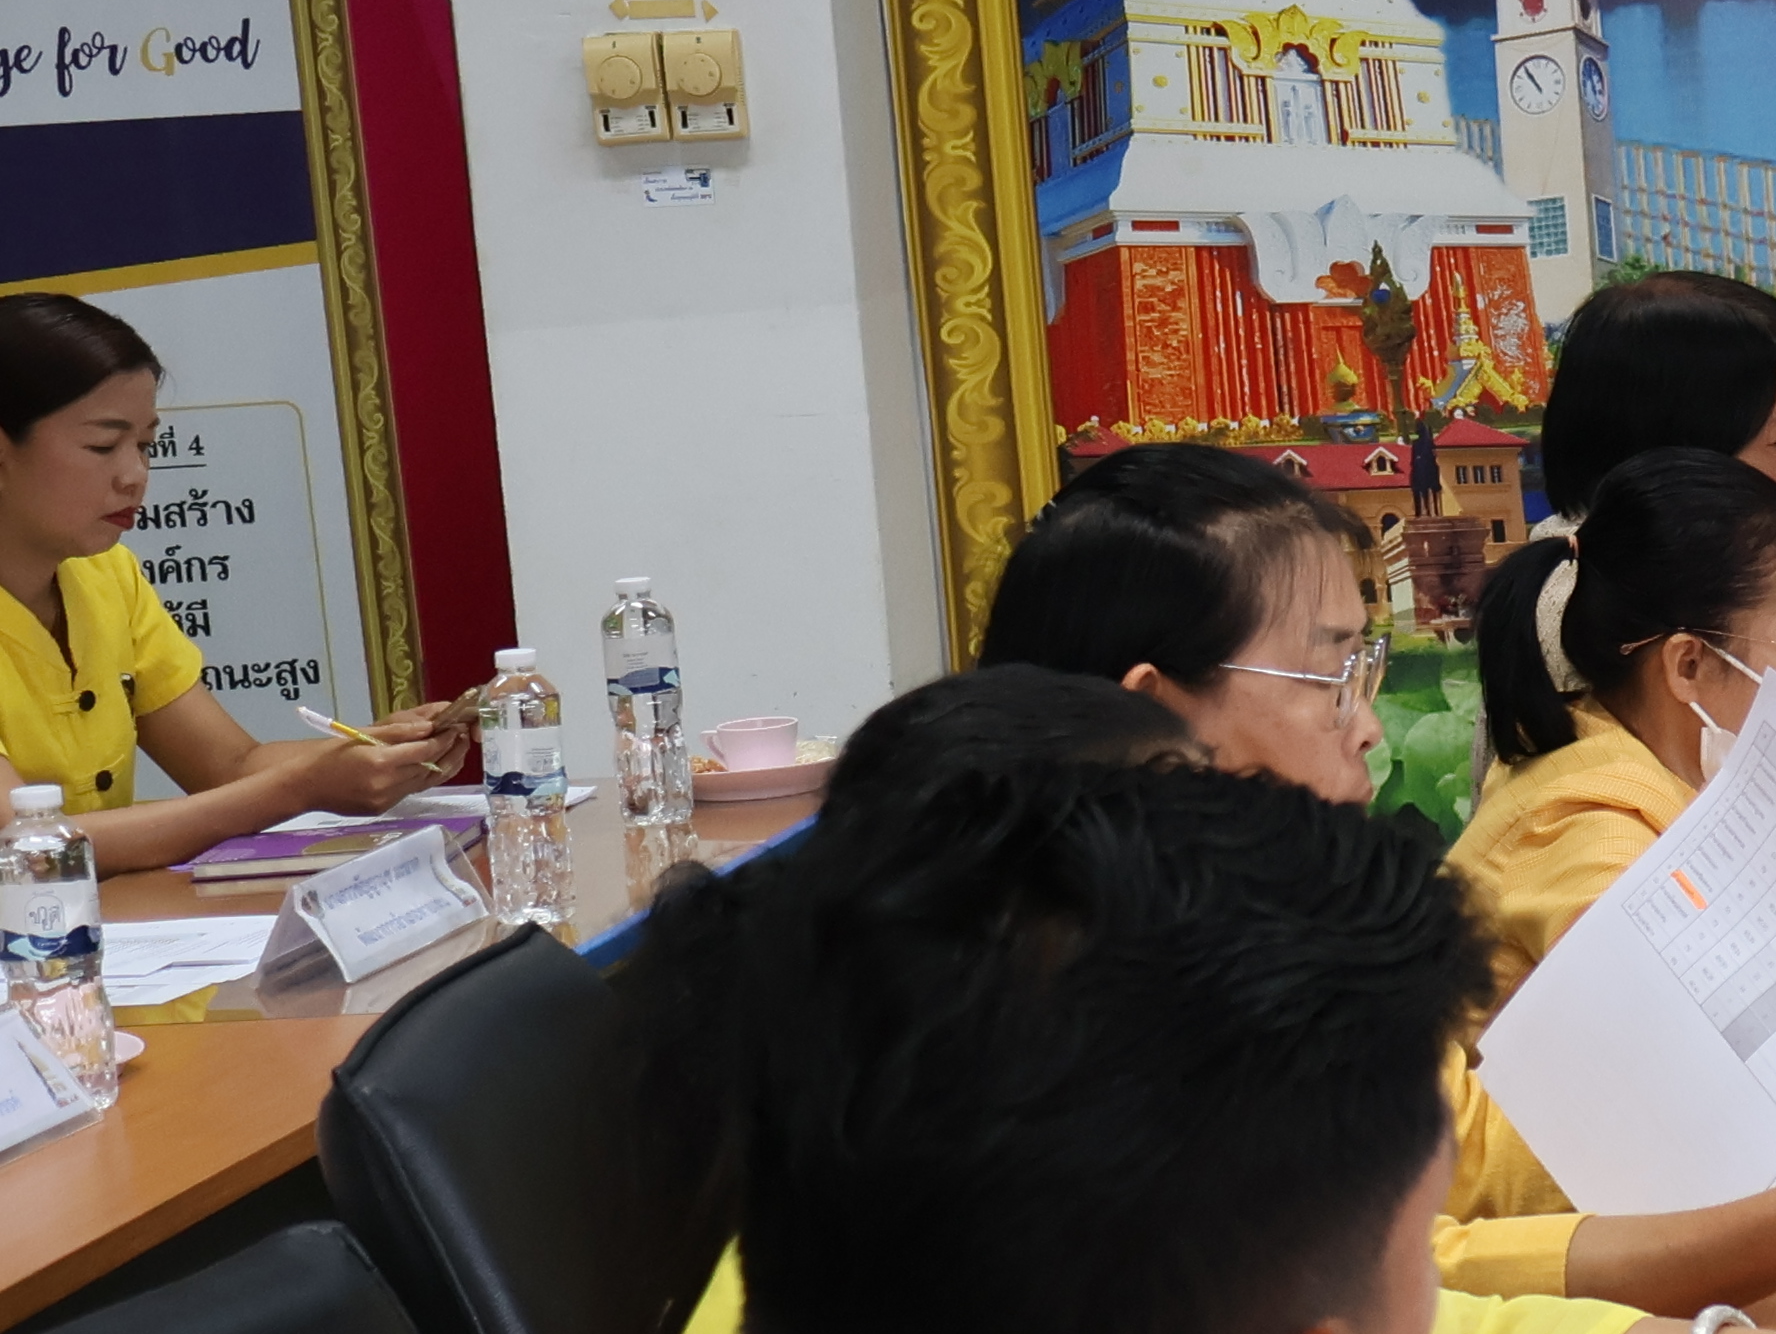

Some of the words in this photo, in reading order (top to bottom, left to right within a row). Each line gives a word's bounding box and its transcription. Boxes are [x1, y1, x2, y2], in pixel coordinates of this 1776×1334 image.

[55, 26, 128, 98] for
[139, 17, 261, 77] Good
[188, 435, 205, 457] 4
[135, 488, 256, 531] มสร้าง
[141, 544, 231, 585] งค์กร
[201, 657, 321, 702] ถนะสูง
